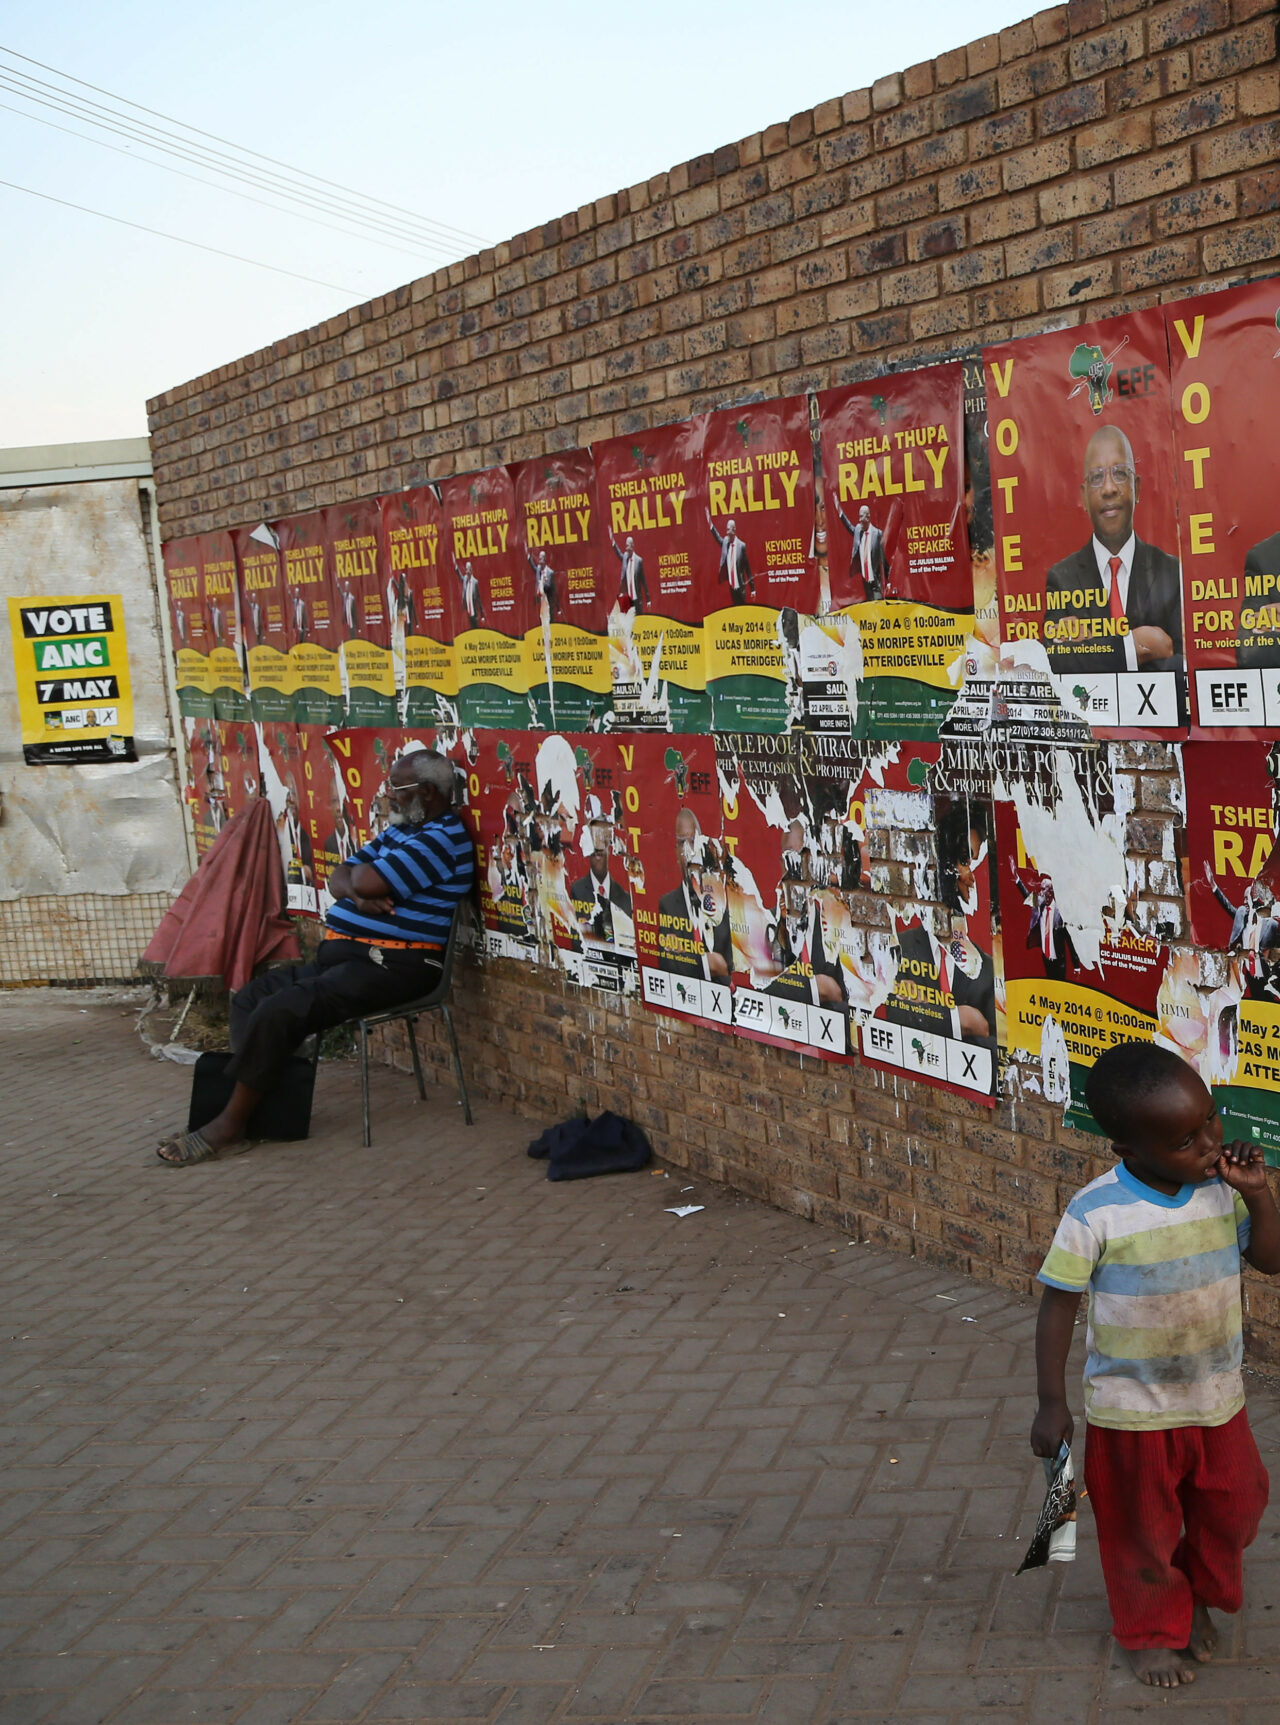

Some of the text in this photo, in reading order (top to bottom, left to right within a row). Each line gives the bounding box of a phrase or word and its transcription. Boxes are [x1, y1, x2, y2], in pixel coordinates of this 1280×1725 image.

[1117, 364, 1155, 397] EFF
[837, 424, 948, 459] TSHELA THUPA
[1173, 314, 1217, 556] VOTE
[708, 450, 799, 478] TSHELA THUPA
[838, 446, 950, 502] RALLY
[990, 358, 1024, 572] VOTE
[608, 471, 685, 498] TSHELA THUPA
[709, 469, 801, 516] RALLY
[524, 493, 590, 516] TSHELA THUPA
[611, 489, 687, 534] RALLY
[414, 523, 438, 537] THUPA
[452, 508, 508, 529] TSHELA THUPA
[526, 510, 591, 549] RALLY
[453, 523, 509, 560] RALLY
[907, 523, 950, 539] KEYNOTE
[390, 538, 438, 571] RALLY
[765, 538, 802, 552] KEYNOTE
[908, 538, 954, 555] SPEAKER:
[335, 549, 378, 578] RALLY
[658, 552, 689, 565] KEYNOTE
[766, 551, 805, 565] SPEAKER:
[244, 565, 277, 590] RALLY
[286, 558, 324, 585] RALLY
[659, 565, 692, 579] SPEAKER:
[1004, 588, 1108, 613] DALI MPOFU
[1191, 577, 1238, 601] DALI
[27, 607, 106, 635] VOTE
[728, 622, 763, 637] May 2014
[859, 616, 955, 632] May 10:00am
[1006, 616, 1130, 641] FOR GAUTENG
[1192, 610, 1235, 633] FOR
[715, 639, 773, 650] LUCAS MORIPE
[877, 634, 964, 649] MORIPE STADIUM
[1047, 644, 1114, 655] of the voiceless.
[1194, 638, 1213, 649] The
[1215, 637, 1241, 648] voice
[1243, 636, 1255, 647] of
[1257, 636, 1274, 646] the
[41, 641, 103, 669] ANC
[863, 653, 945, 668] ATTERIDGEVILLE
[40, 679, 112, 702] 7 MAY
[1210, 683, 1248, 708] EFF
[1092, 698, 1109, 711] EFF
[65, 714, 81, 723] ANC
[1040, 728, 1086, 739] 306 8511/12
[300, 732, 318, 839] VOTE
[333, 737, 367, 846] VOTE
[636, 909, 693, 933] DALI MPOFU
[638, 929, 705, 955] FOR GAUTENG
[1132, 954, 1157, 966] MALEMA
[648, 976, 665, 994] EFF
[739, 997, 764, 1018] EFF
